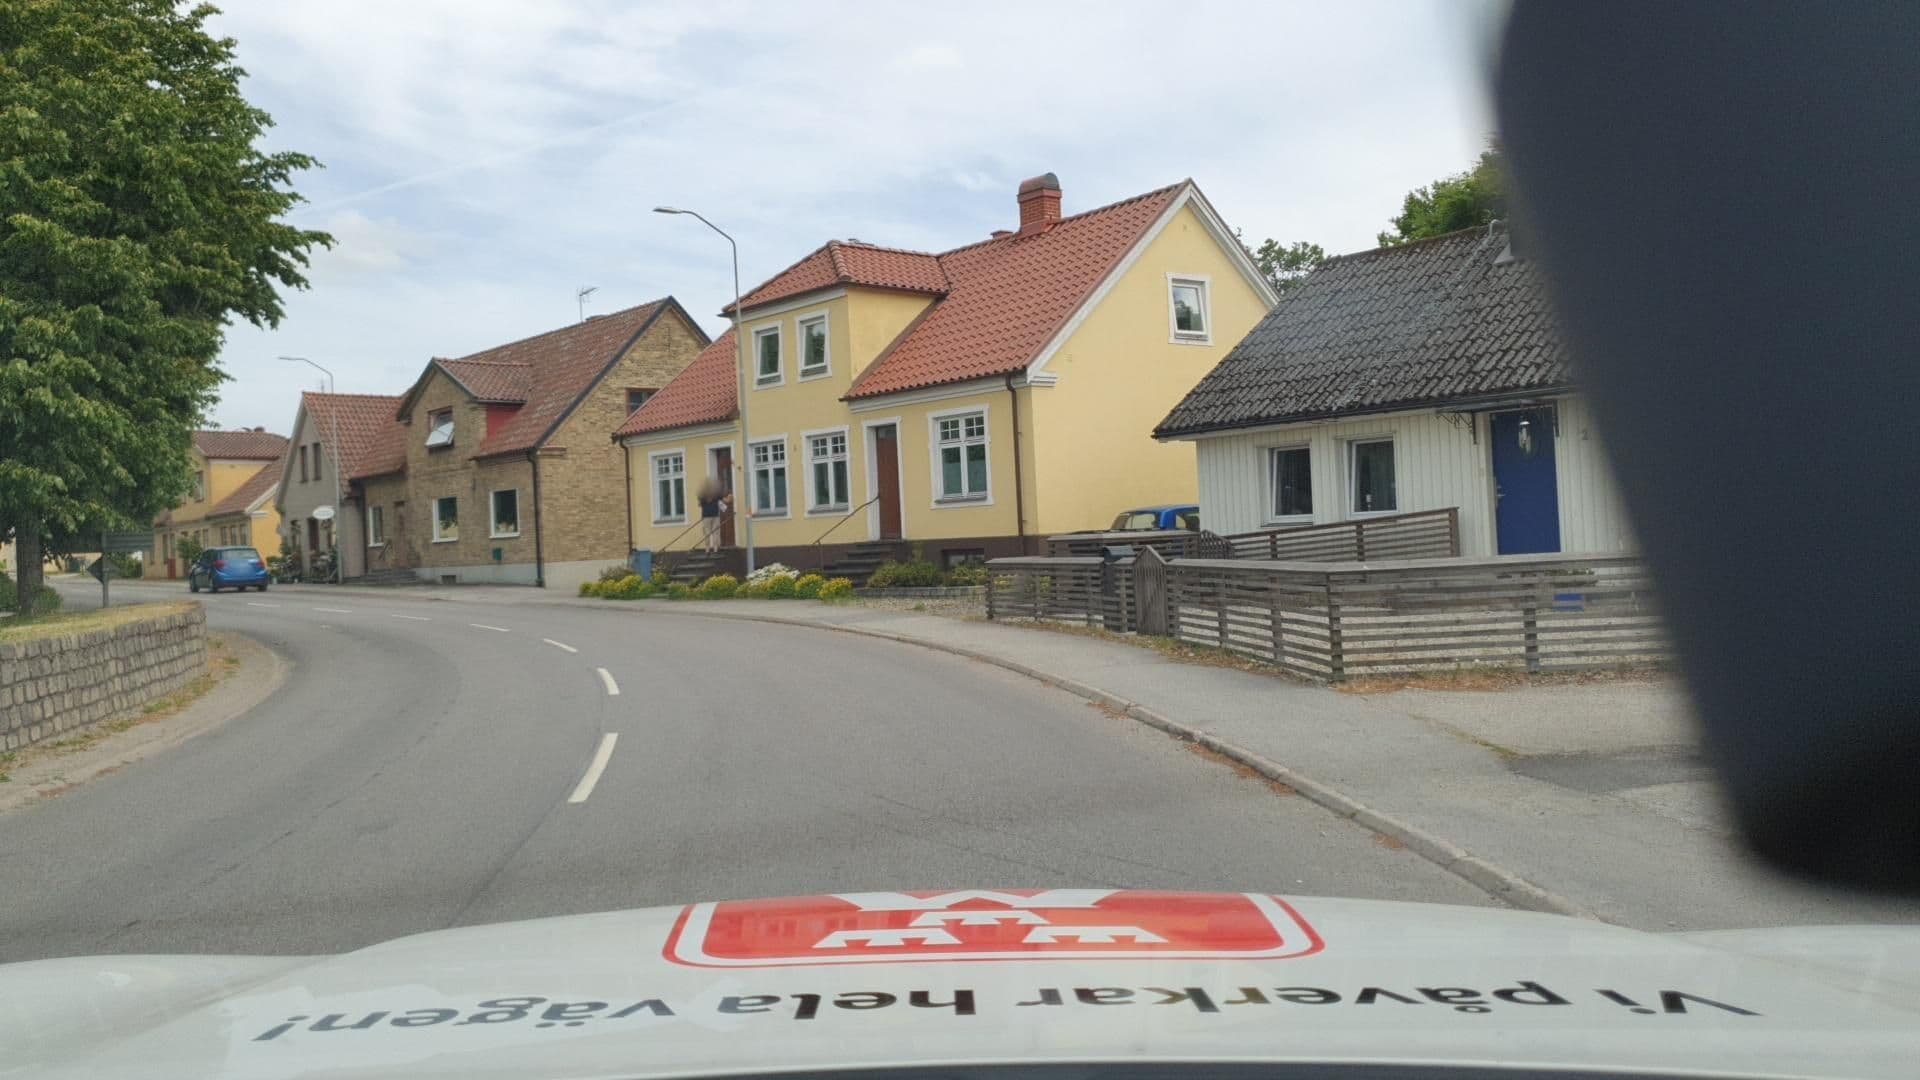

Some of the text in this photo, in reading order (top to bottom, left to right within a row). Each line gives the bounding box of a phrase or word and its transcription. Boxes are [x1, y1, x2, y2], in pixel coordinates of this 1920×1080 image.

[251, 981, 1763, 1041] Vi påverkar hela vägen!
